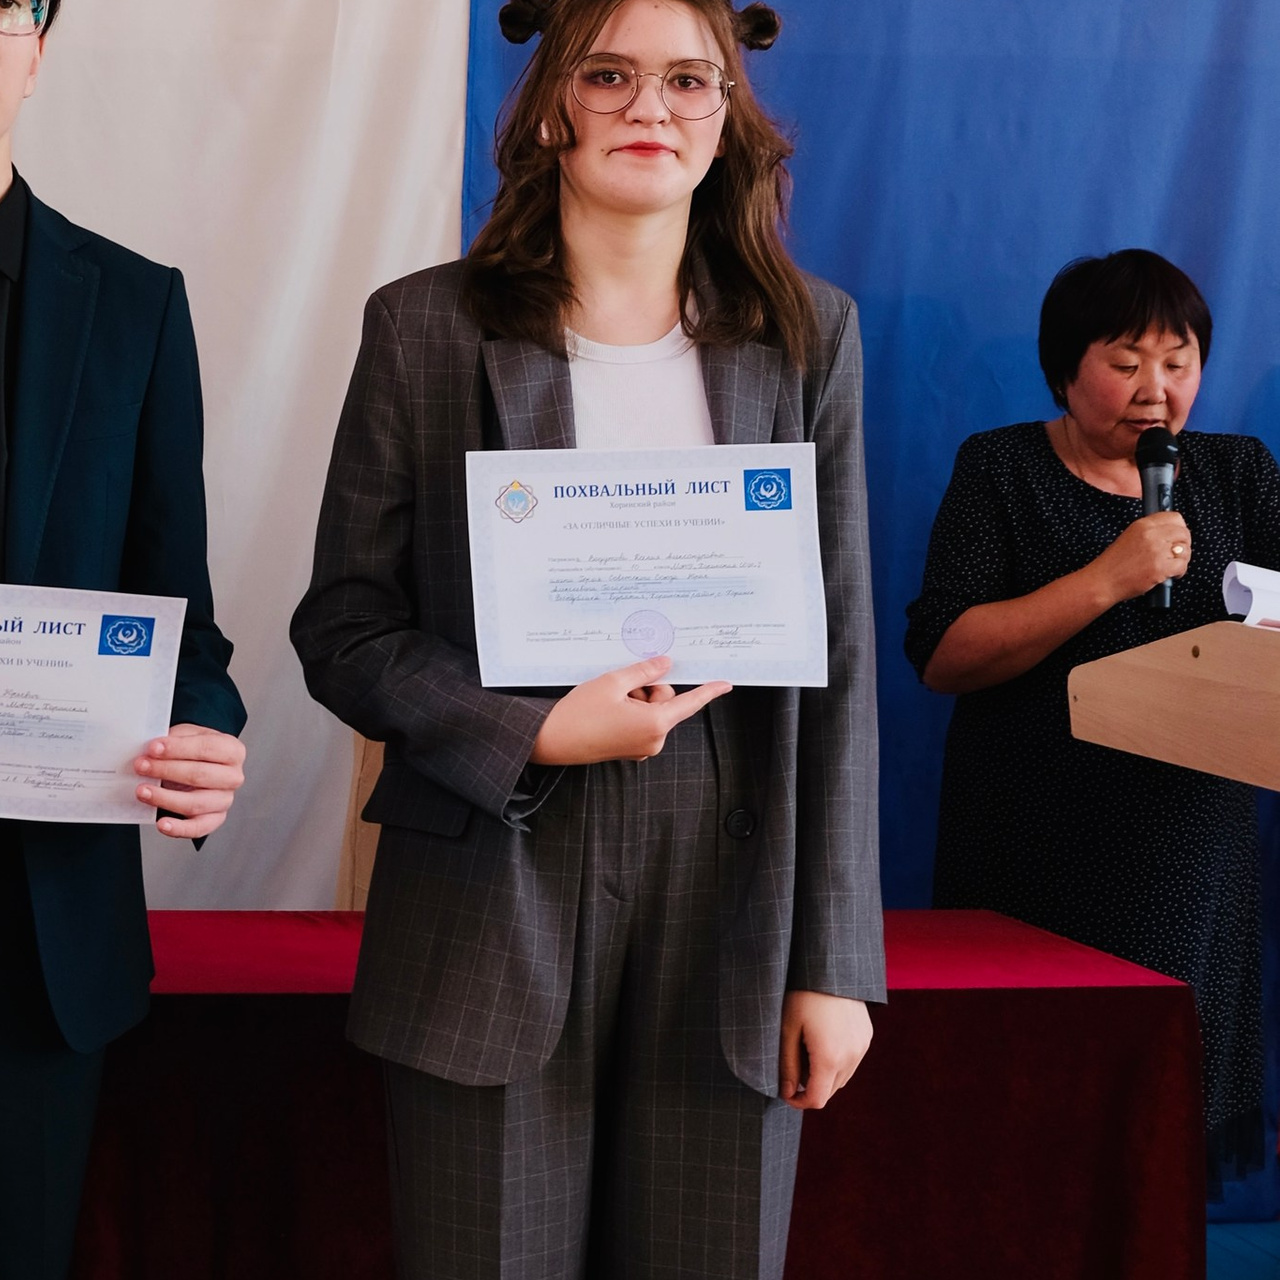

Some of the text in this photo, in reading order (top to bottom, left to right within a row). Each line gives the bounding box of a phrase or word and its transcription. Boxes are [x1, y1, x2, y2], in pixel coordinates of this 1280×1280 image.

[554, 479, 731, 499] ПОХВАЛЬНЫЙ ЛИСТ
[580, 520, 631, 530] ОТЛИЧНЫЕ
[634, 519, 672, 528] УСПЕХИ
[674, 519, 681, 527] В
[33, 621, 86, 636] ЛИСТ
[16, 658, 24, 666] В
